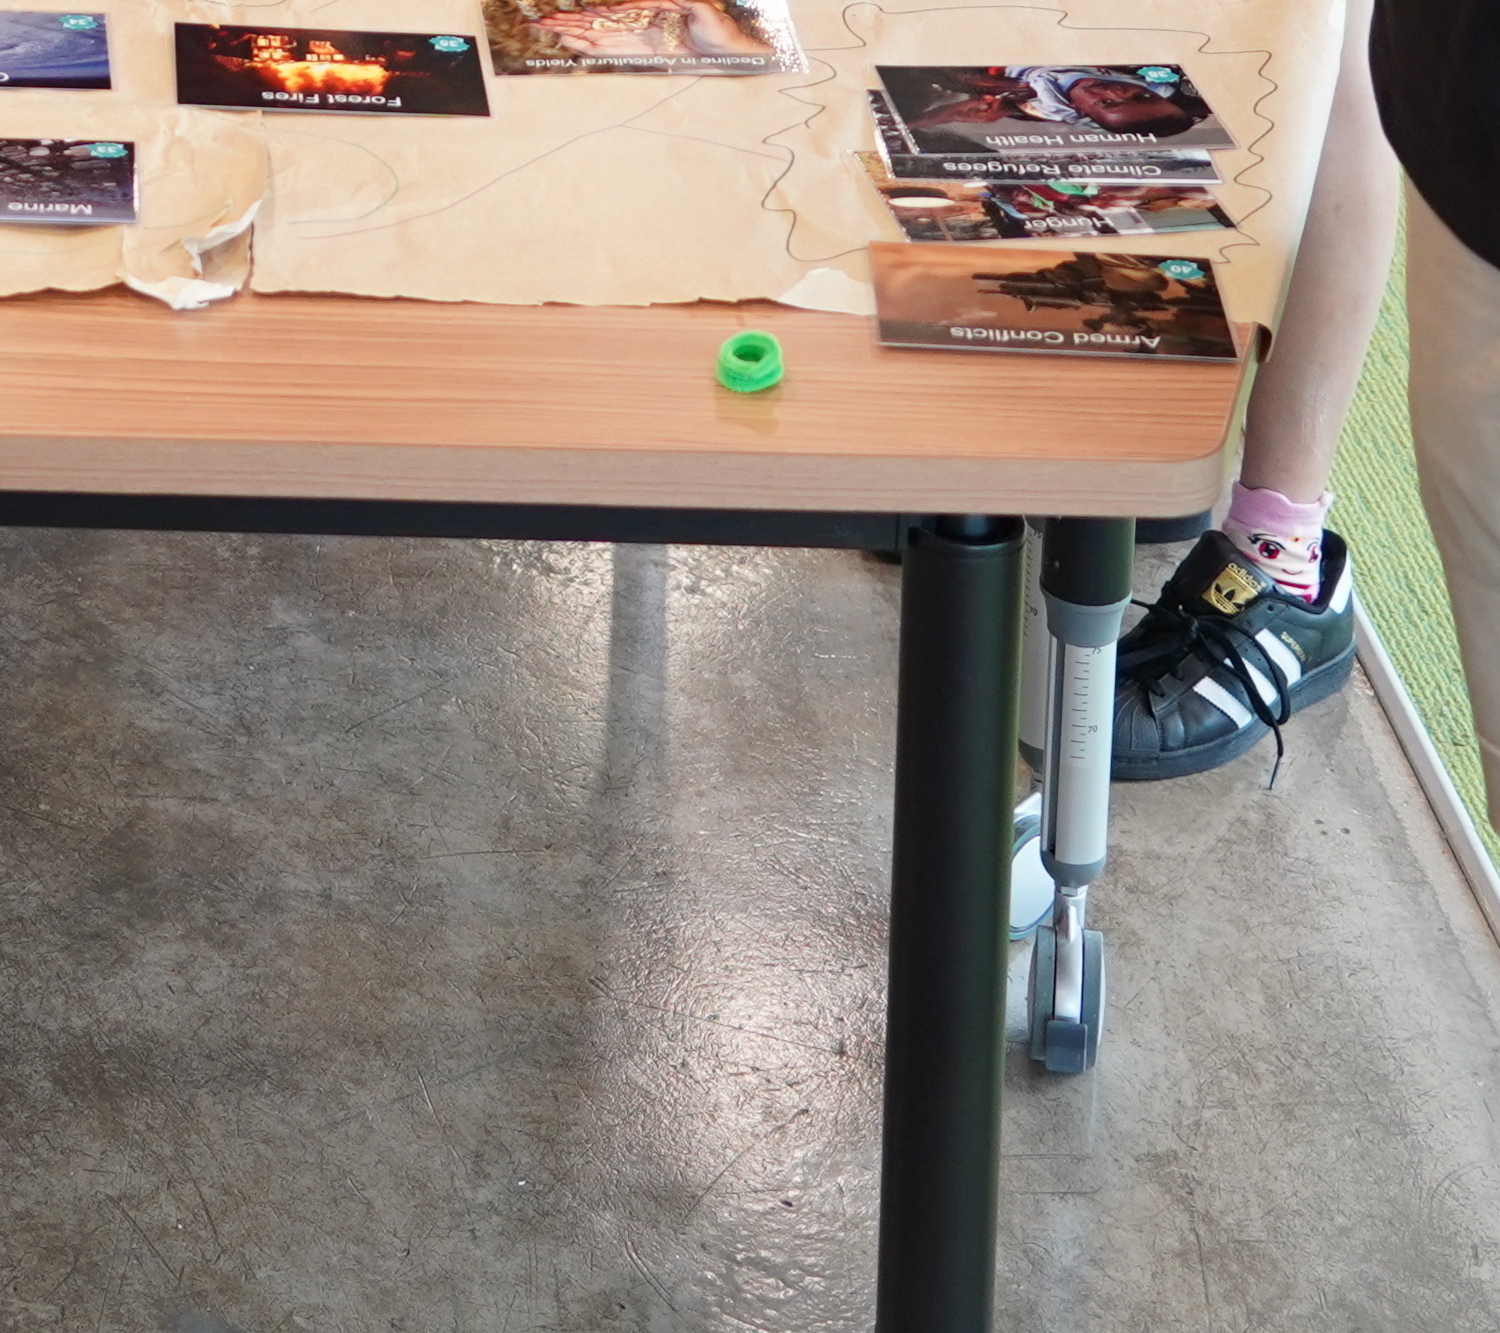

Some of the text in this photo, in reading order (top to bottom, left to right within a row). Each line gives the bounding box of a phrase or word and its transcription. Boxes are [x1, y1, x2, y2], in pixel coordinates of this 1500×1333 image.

[440, 39, 458, 47] 35
[526, 55, 765, 69] Decline in Agricultural Yields
[261, 91, 401, 106] Forest Fires
[986, 131, 1157, 146] Human Health
[943, 160, 1162, 176] Climate Refugees
[8, 202, 93, 214] Marine
[1023, 215, 1112, 231] Hunger
[1170, 265, 1192, 274] 40
[950, 326, 1161, 347] Armed Conflicts
[1228, 562, 1266, 591] adidas
[1088, 725, 1098, 733] 70
